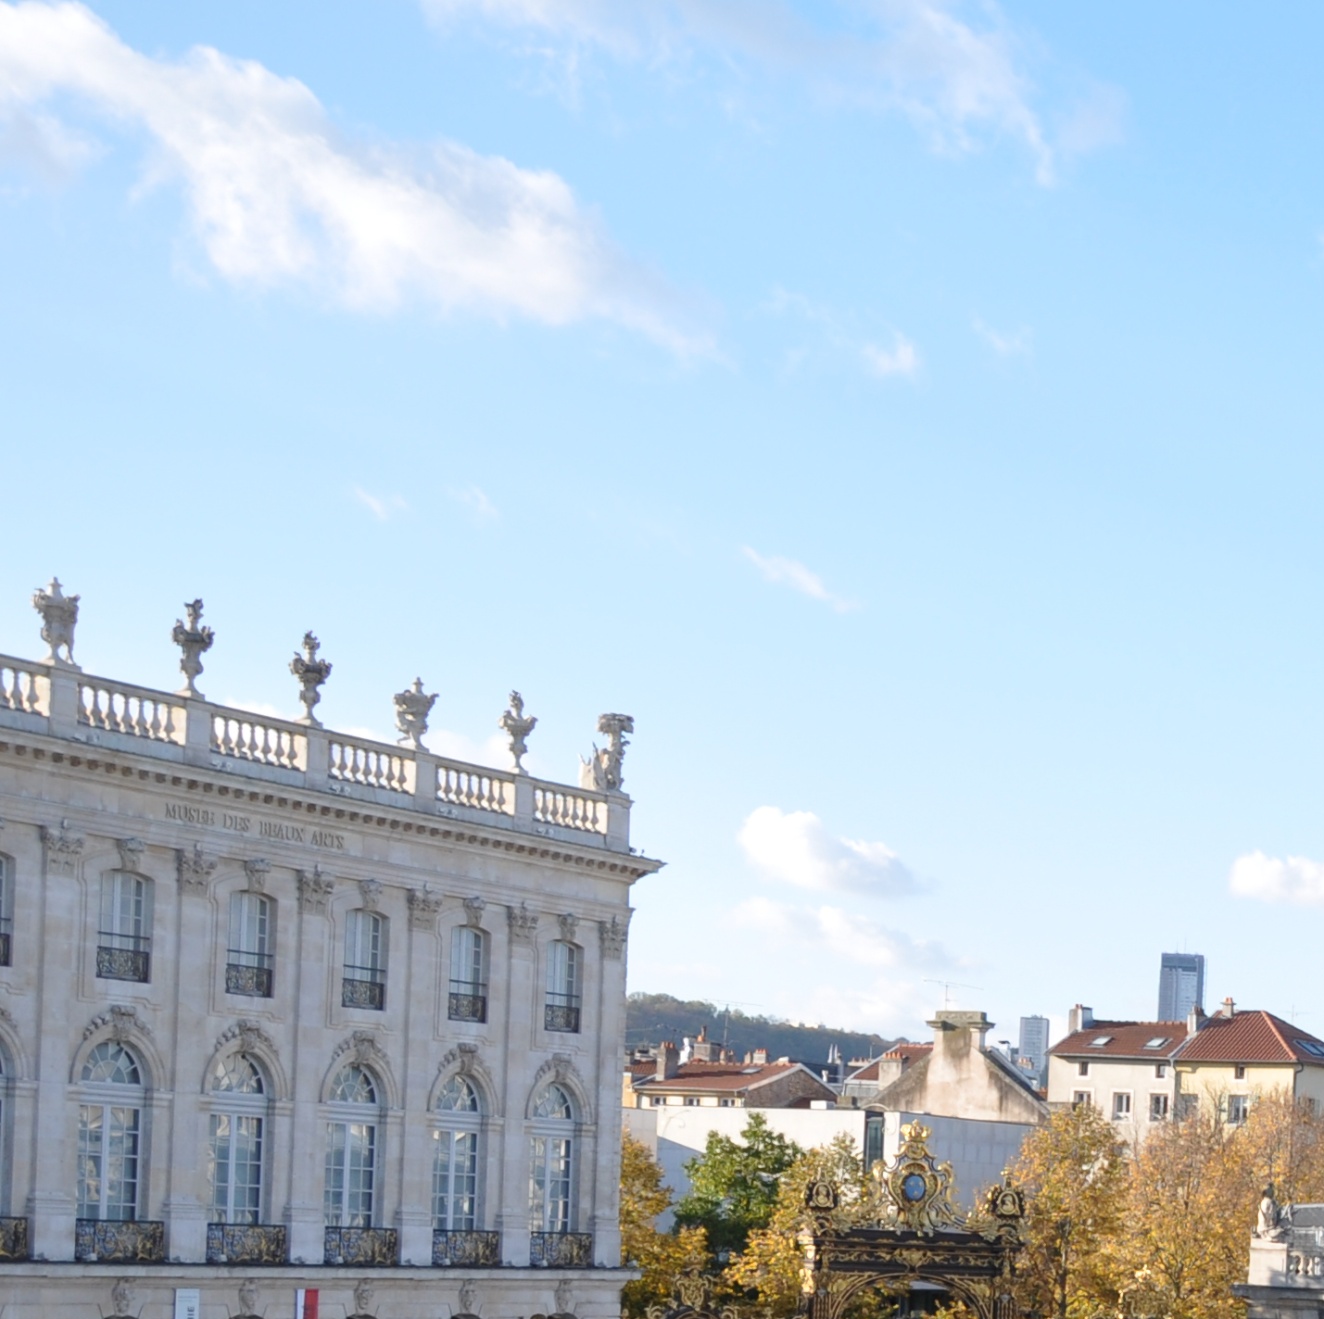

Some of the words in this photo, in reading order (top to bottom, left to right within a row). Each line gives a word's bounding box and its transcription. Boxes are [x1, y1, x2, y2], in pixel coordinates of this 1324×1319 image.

[165, 803, 214, 825] MUSEE
[223, 813, 250, 832] DES
[259, 821, 304, 842] BEAUX
[311, 831, 344, 849] ARTS
